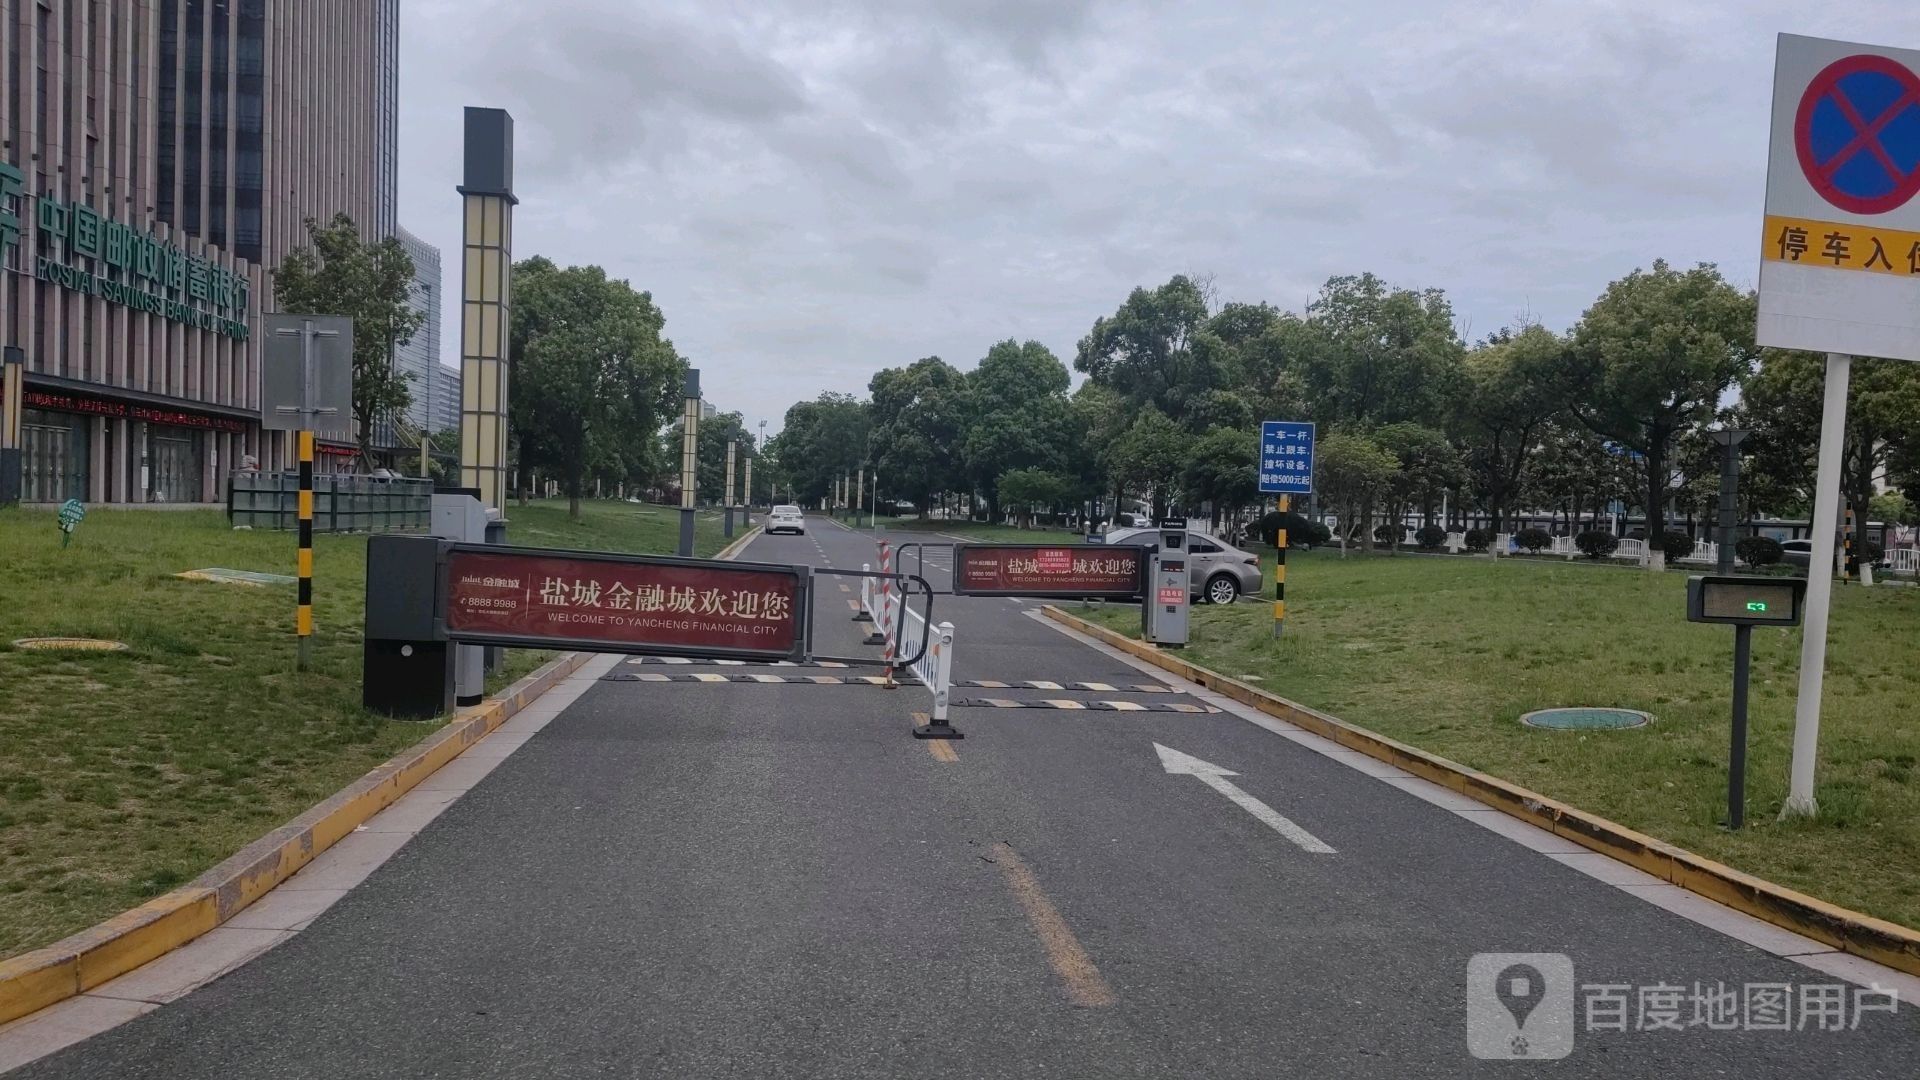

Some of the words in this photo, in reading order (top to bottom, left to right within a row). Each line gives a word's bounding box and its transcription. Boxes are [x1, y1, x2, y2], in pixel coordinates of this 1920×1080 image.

[38, 190, 250, 311] 中国邮政储蓄银行
[104, 279, 164, 316] SAVINGS
[167, 300, 200, 328] BANK
[220, 318, 250, 340] CHINA
[1261, 473, 1310, 485] 赔偿5000元起
[1008, 558, 1136, 575] 盐城城欢迎您
[483, 577, 520, 589] 金融城
[468, 597, 491, 607] 8888
[493, 599, 517, 609] 9988
[539, 576, 790, 621] 盐城金融城欢迎您
[548, 612, 605, 625] WELCOME
[609, 616, 624, 626] TO
[628, 617, 689, 630] YANCHENG
[692, 621, 749, 634] FINANCIAL
[753, 625, 778, 635] CITY
